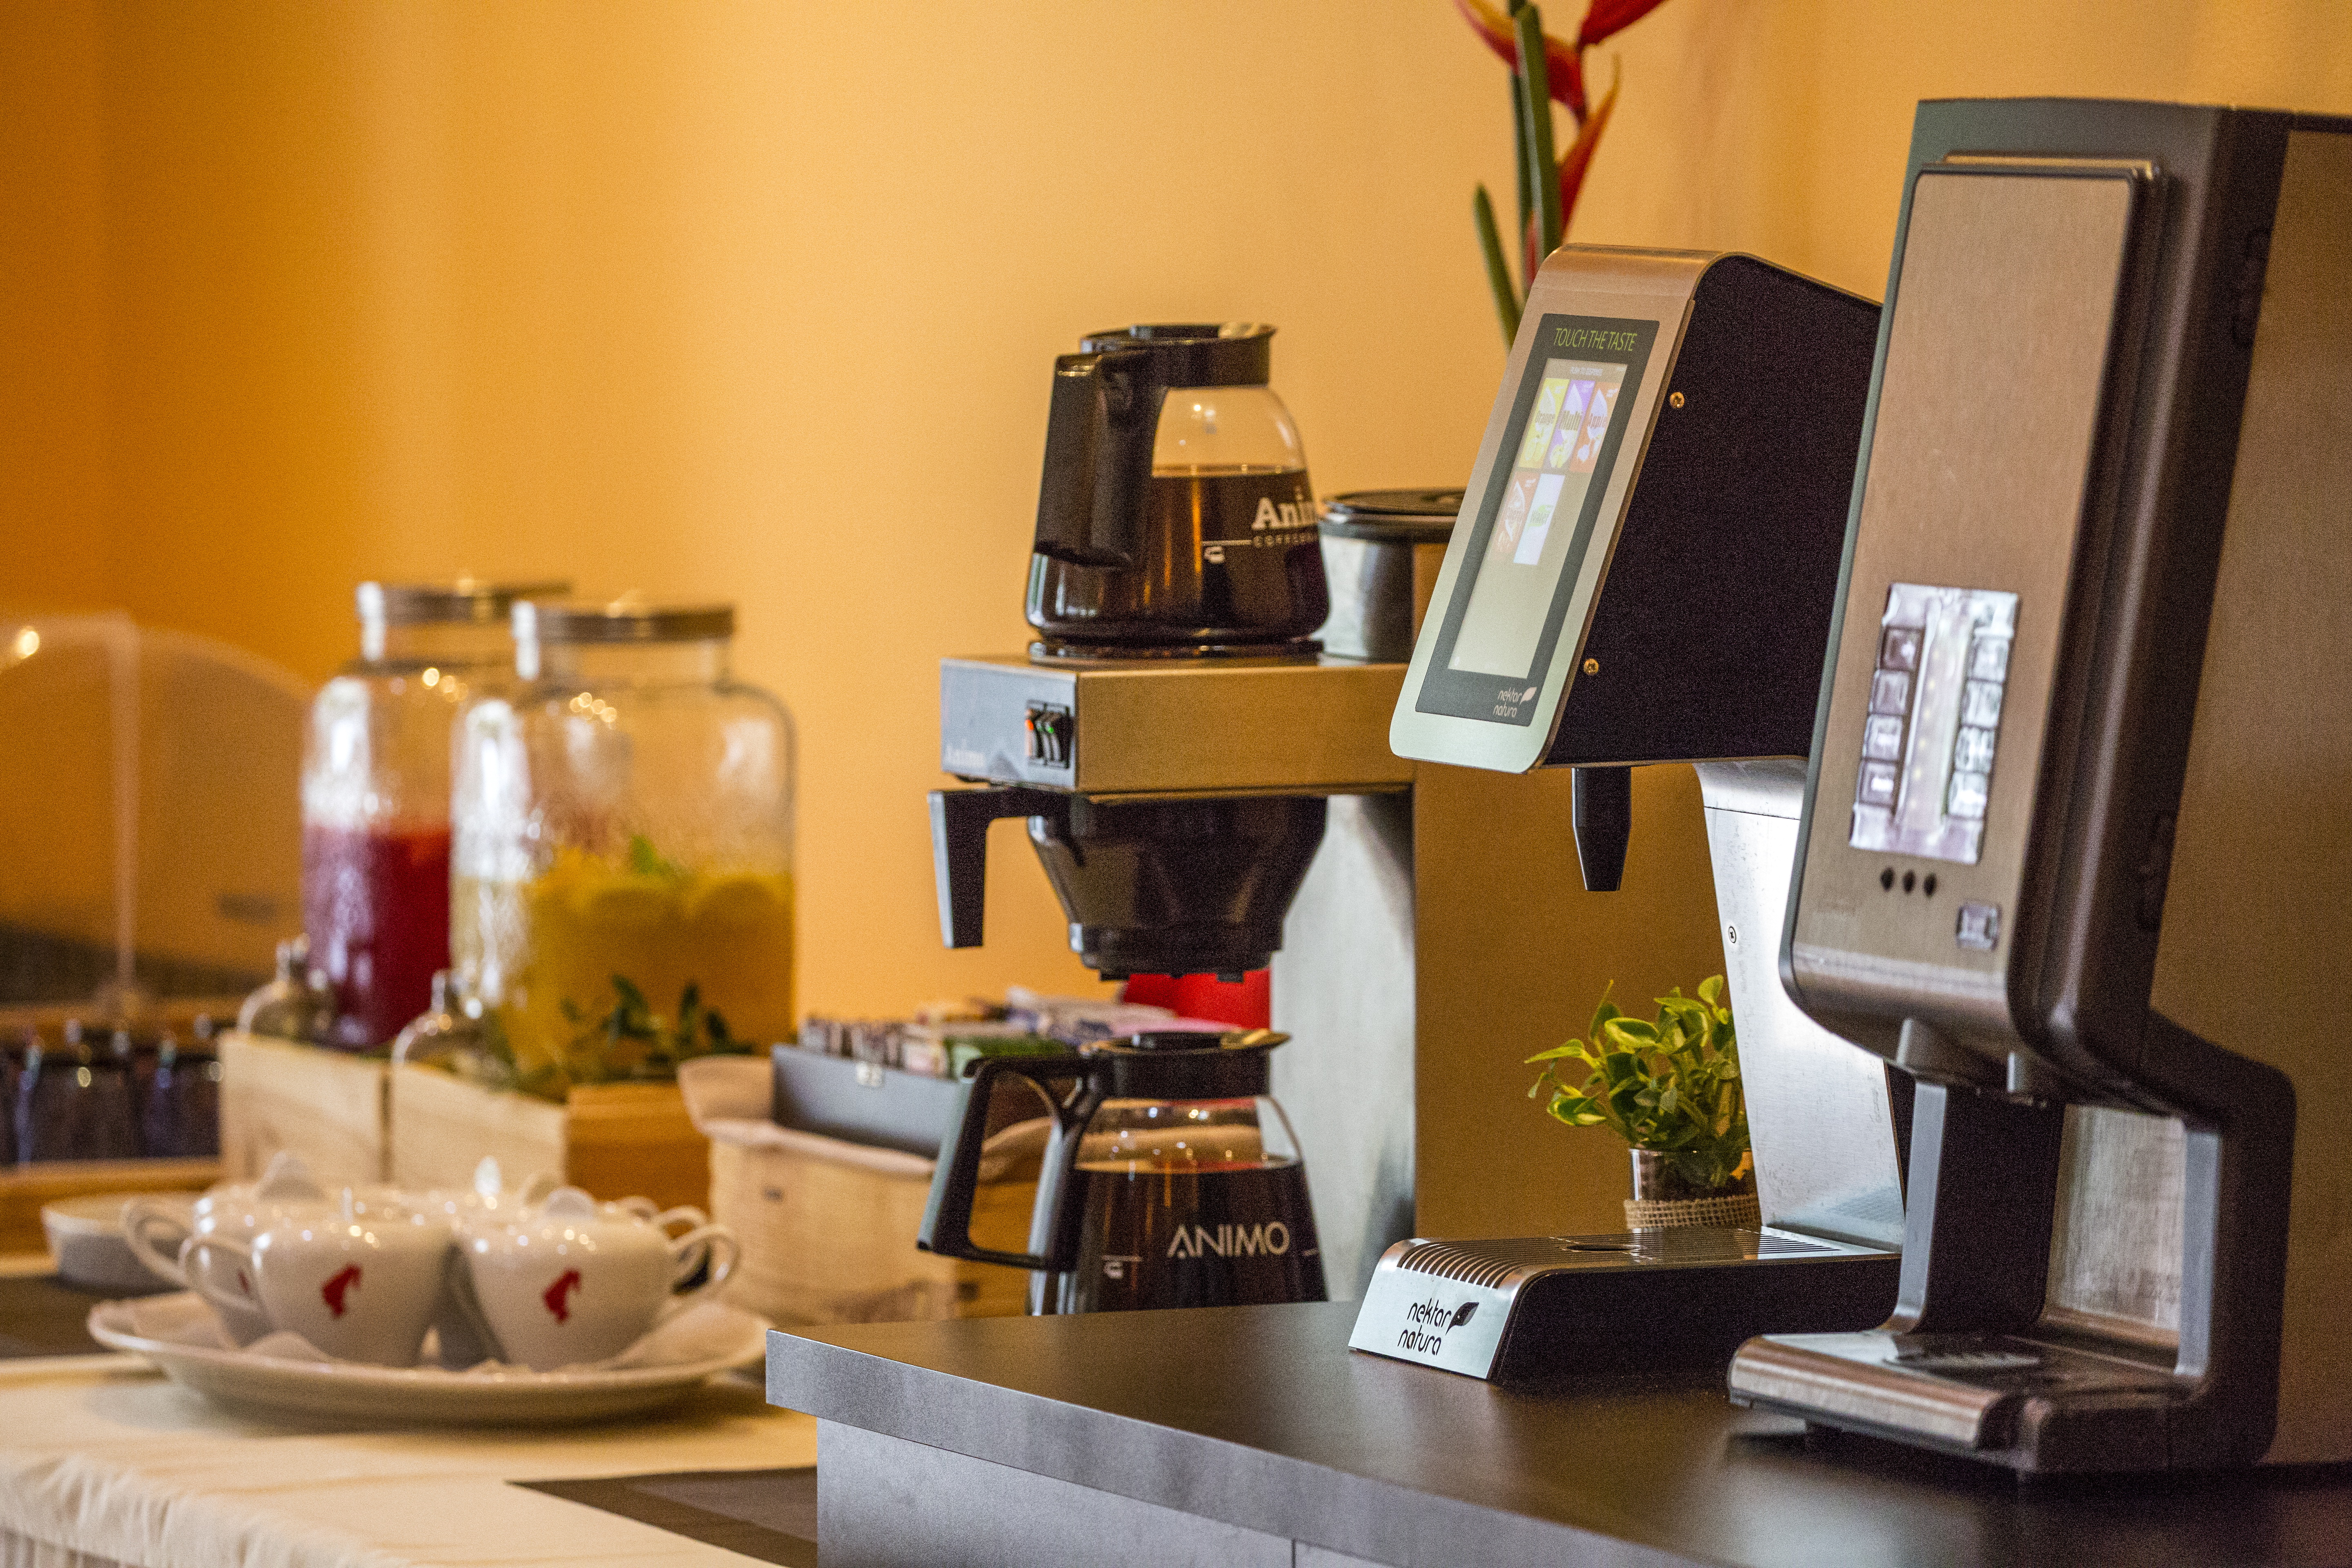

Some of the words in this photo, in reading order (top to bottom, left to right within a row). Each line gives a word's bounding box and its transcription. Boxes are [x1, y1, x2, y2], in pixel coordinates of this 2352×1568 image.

[1553, 327, 1587, 348] TOUCH
[1588, 330, 1608, 350] THE
[1608, 332, 1637, 352] TASTE
[1493, 699, 1517, 717] natura
[1498, 687, 1522, 703] nektar
[1167, 1221, 1290, 1258] ANIMO
[1407, 1298, 1452, 1327] nektar
[1397, 1325, 1441, 1356] natura
